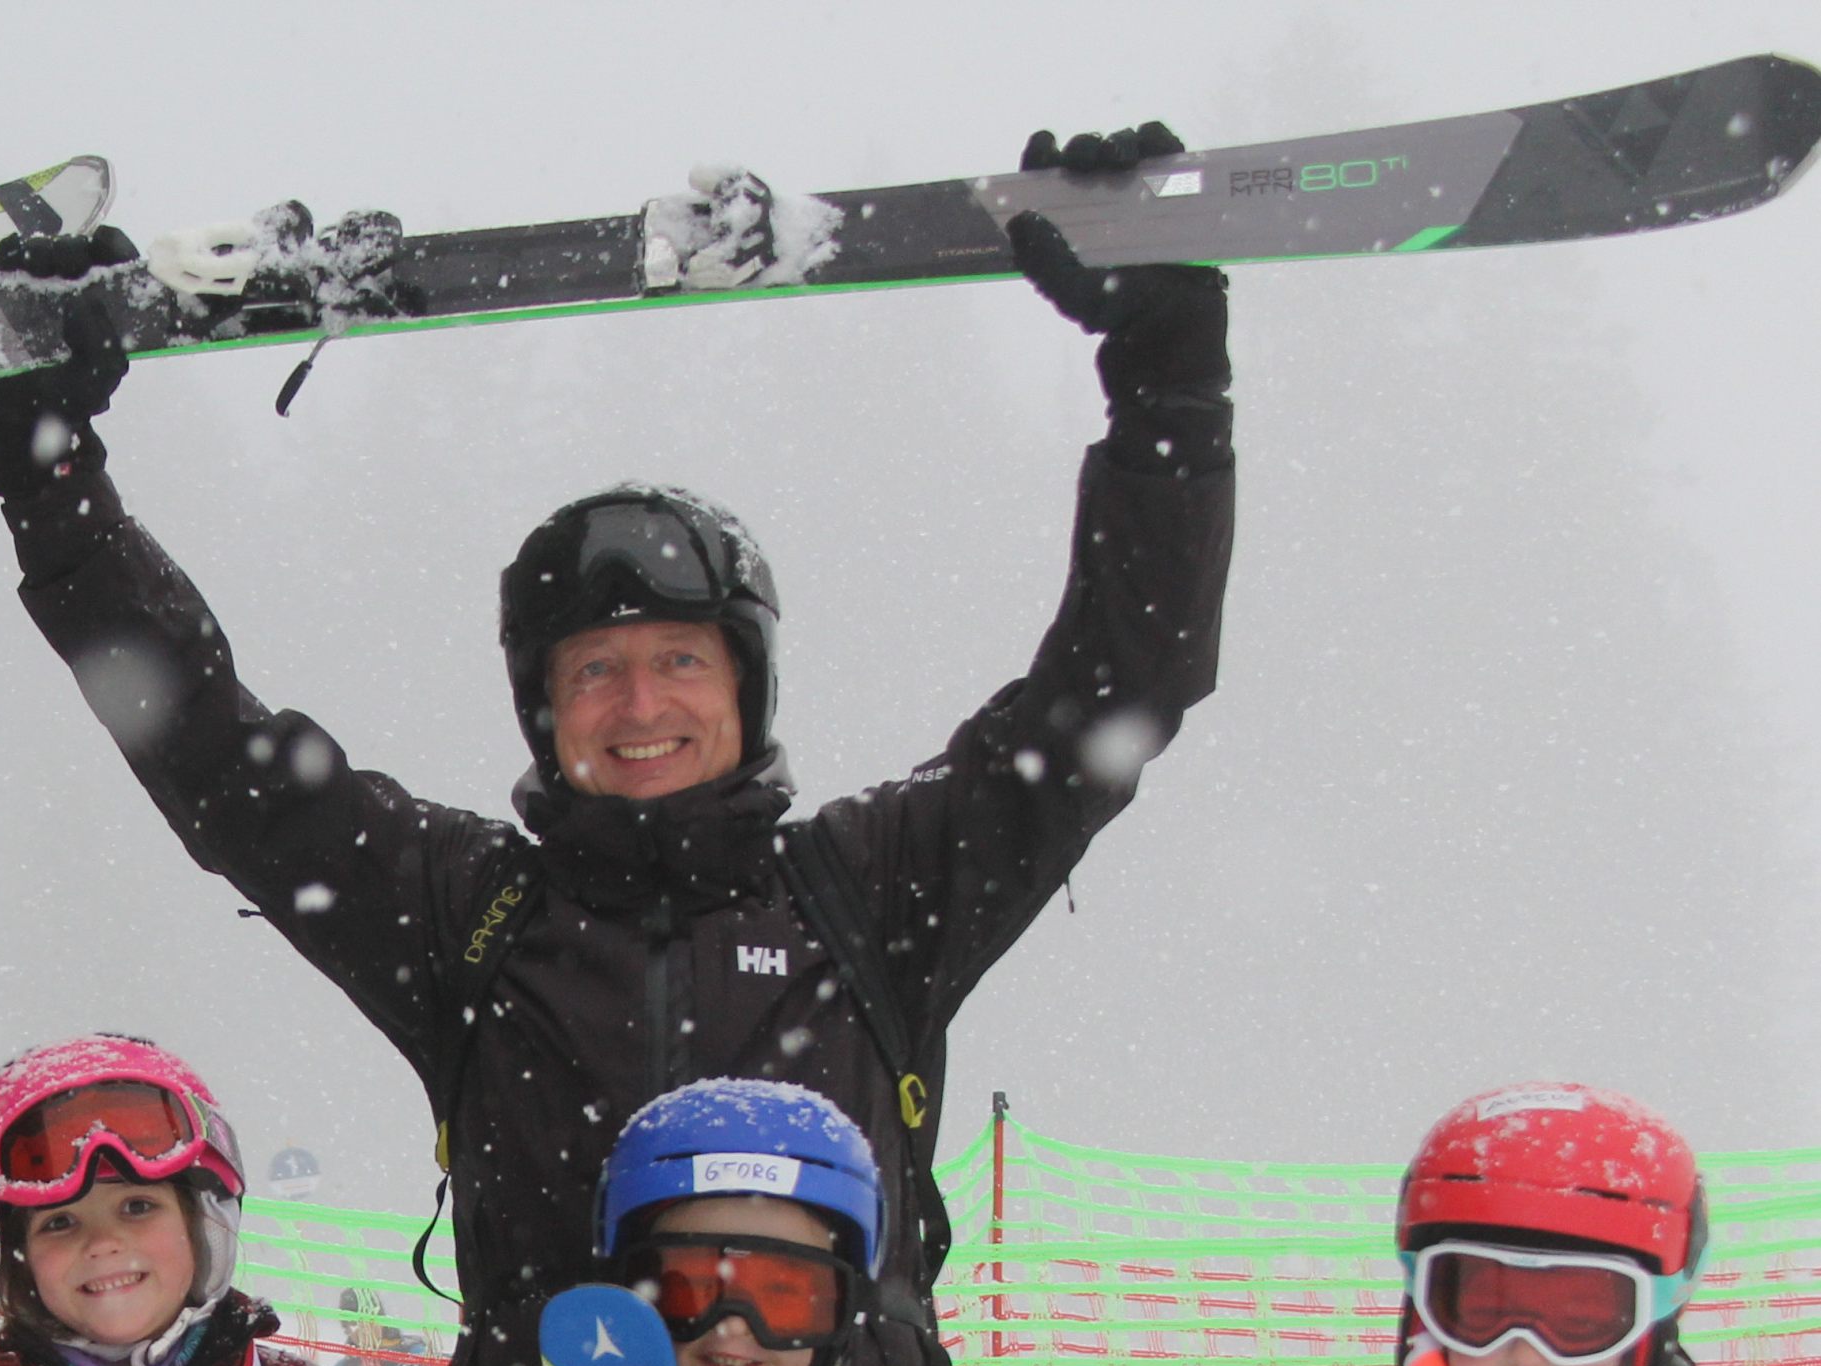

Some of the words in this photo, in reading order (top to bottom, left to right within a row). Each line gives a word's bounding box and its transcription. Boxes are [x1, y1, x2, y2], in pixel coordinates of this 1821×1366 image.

[1230, 166, 1293, 182] PRO
[1299, 159, 1378, 193] 80
[1230, 181, 1293, 197] MTN
[736, 945, 788, 976] HH
